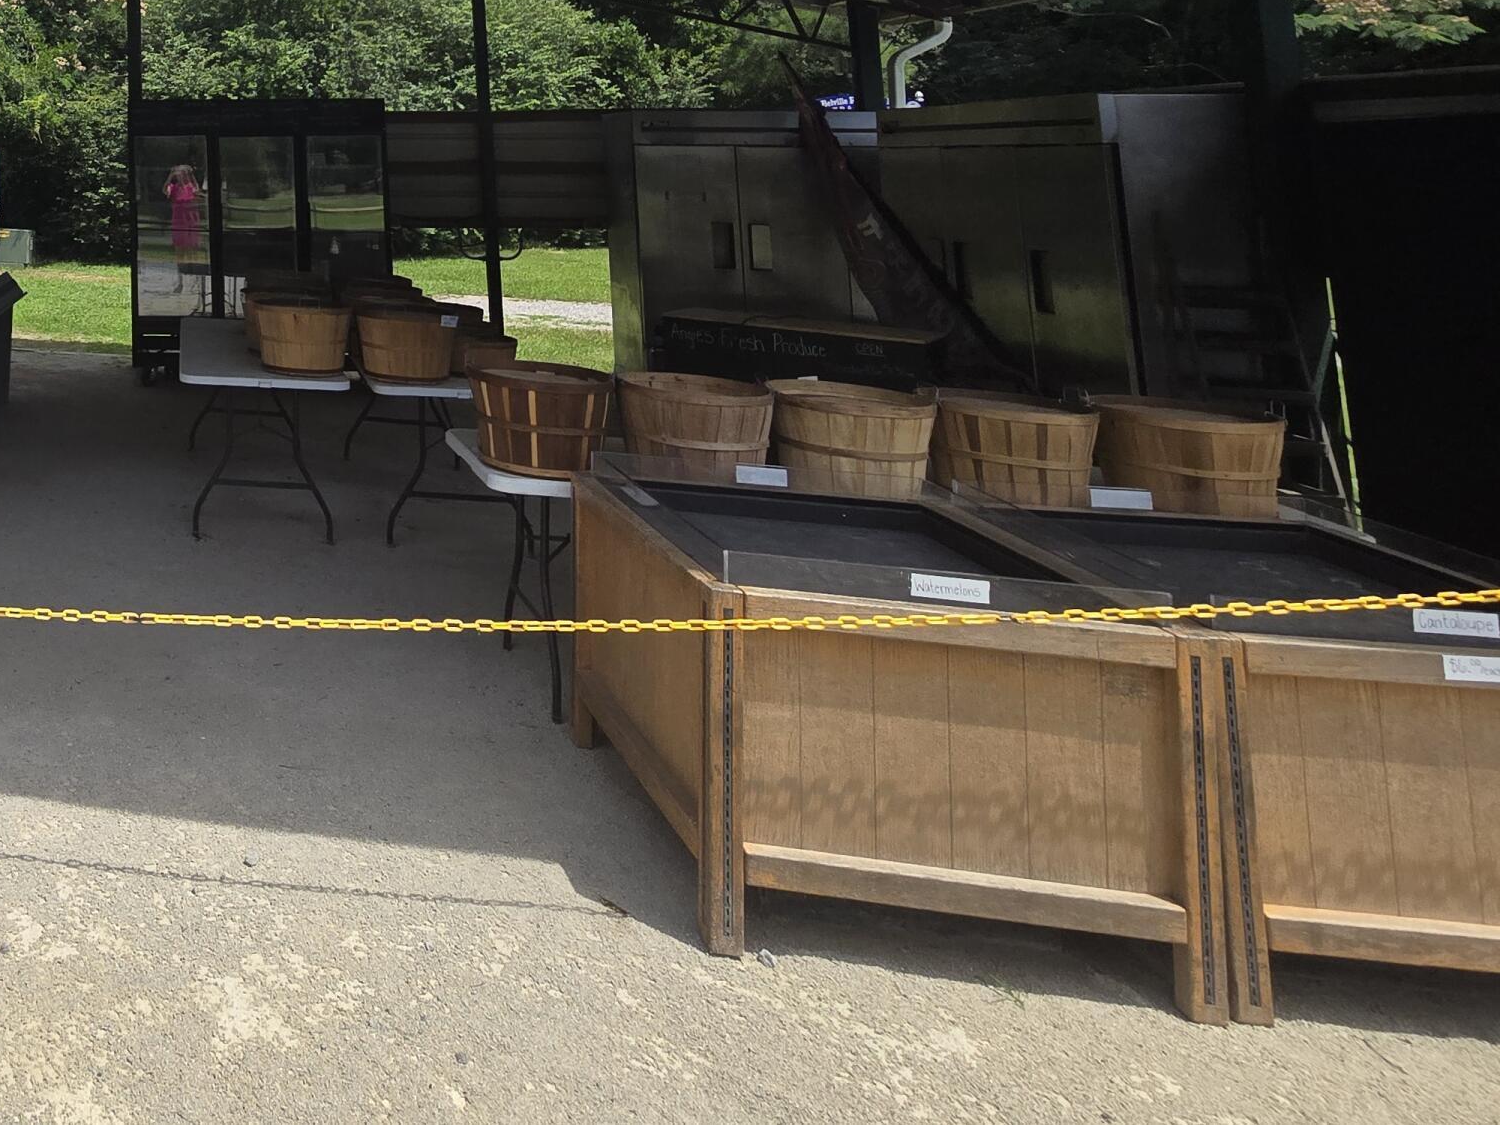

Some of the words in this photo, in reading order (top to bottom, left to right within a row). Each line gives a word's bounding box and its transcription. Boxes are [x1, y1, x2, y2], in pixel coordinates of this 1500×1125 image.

[773, 332, 827, 357] Produce
[915, 578, 981, 597] Watermelons
[1419, 611, 1494, 633] Cantaloupe
